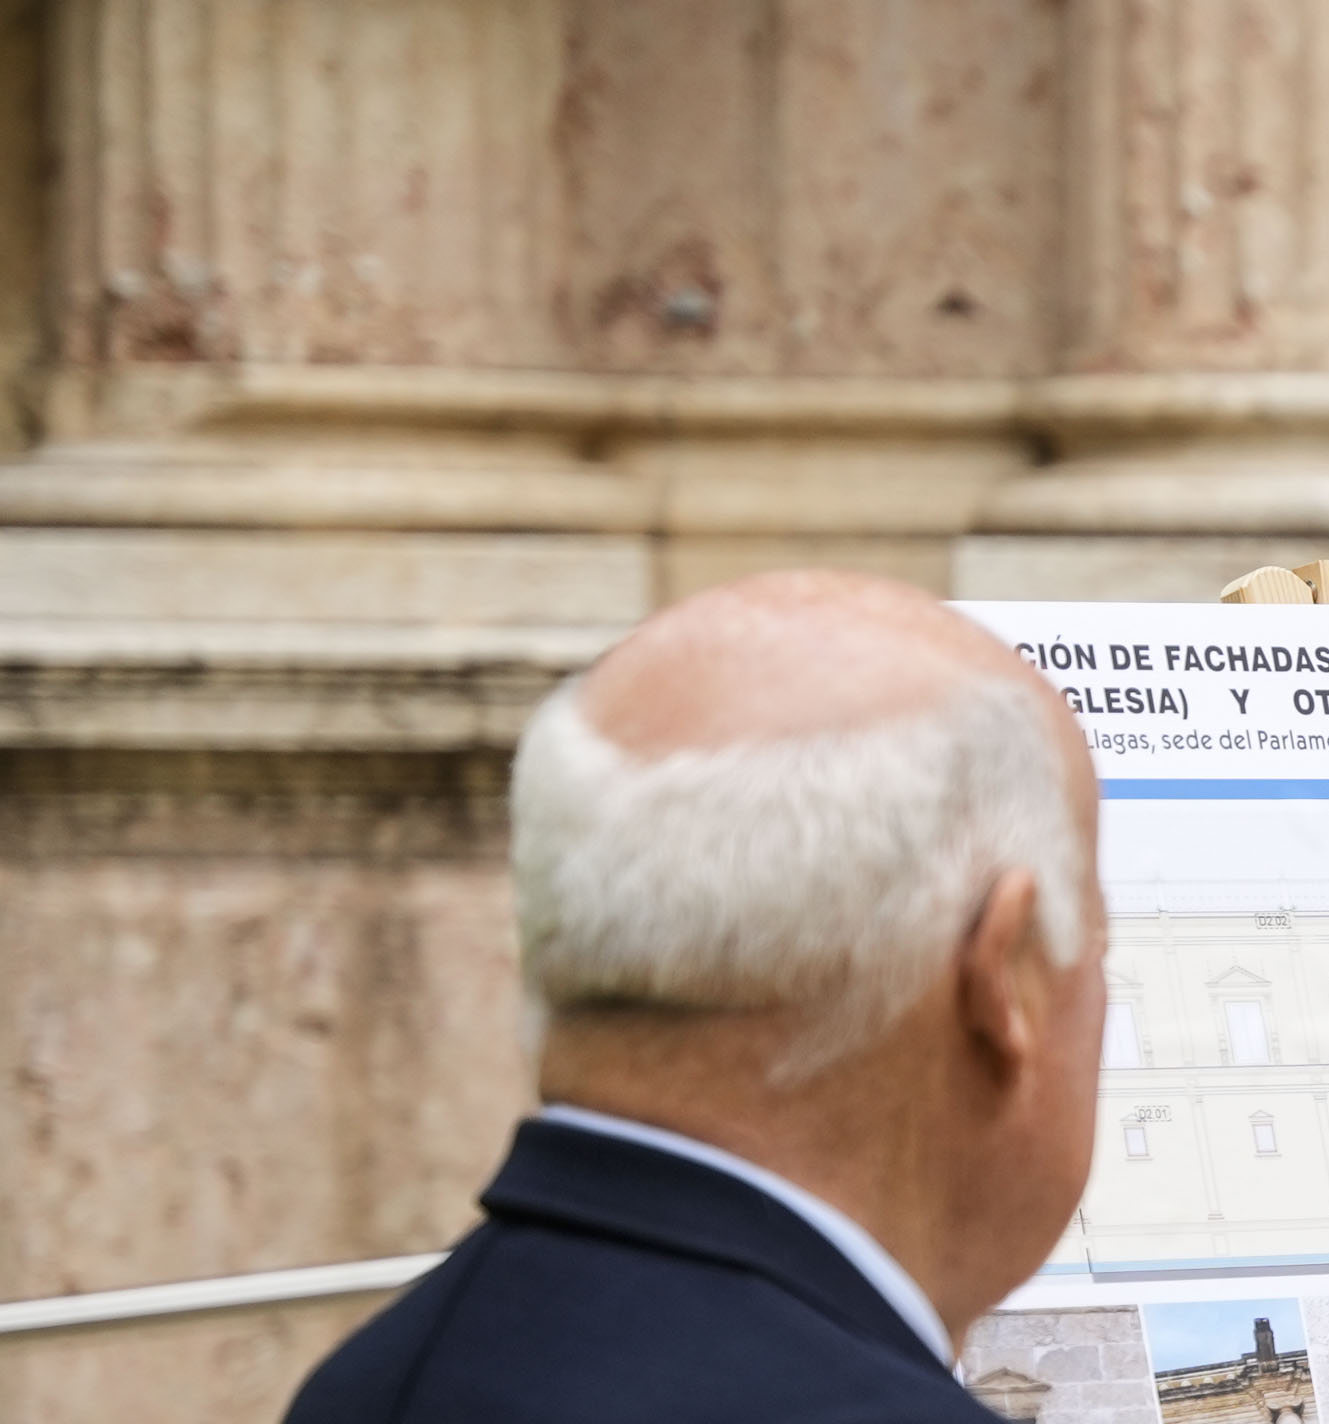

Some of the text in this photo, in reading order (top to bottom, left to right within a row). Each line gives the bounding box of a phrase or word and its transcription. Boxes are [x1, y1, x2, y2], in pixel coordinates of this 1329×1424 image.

[1013, 635, 1097, 671] CIÓN
[1109, 644, 1153, 671] DE
[1061, 686, 1188, 720] GLESIA)
[1229, 688, 1250, 715] Y
[1162, 729, 1213, 750] sede
[1219, 729, 1251, 750] del
